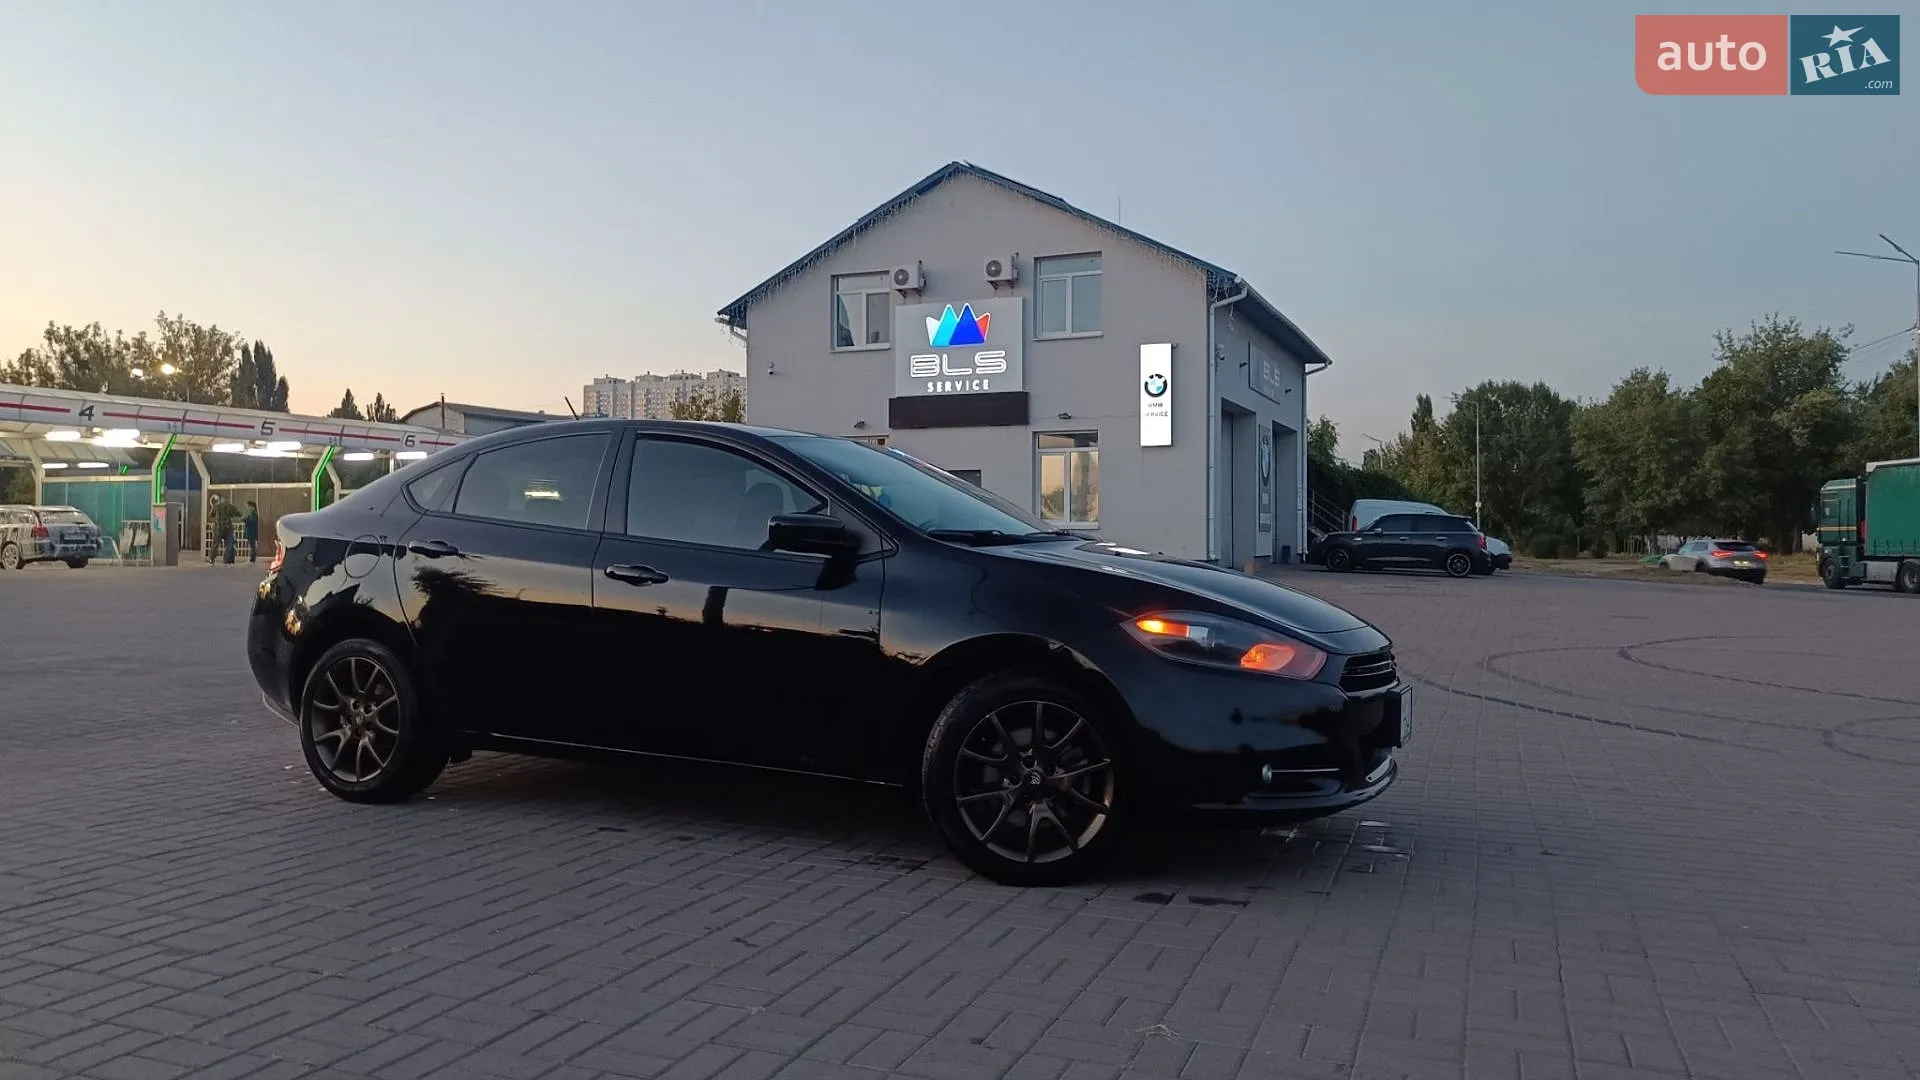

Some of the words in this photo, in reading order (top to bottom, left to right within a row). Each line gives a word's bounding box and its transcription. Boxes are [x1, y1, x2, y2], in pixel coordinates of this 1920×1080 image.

[909, 350, 1007, 378] BLS
[926, 378, 990, 393] SERVICE
[78, 404, 95, 422] 4
[260, 421, 276, 437] 5
[404, 435, 416, 449] 6
